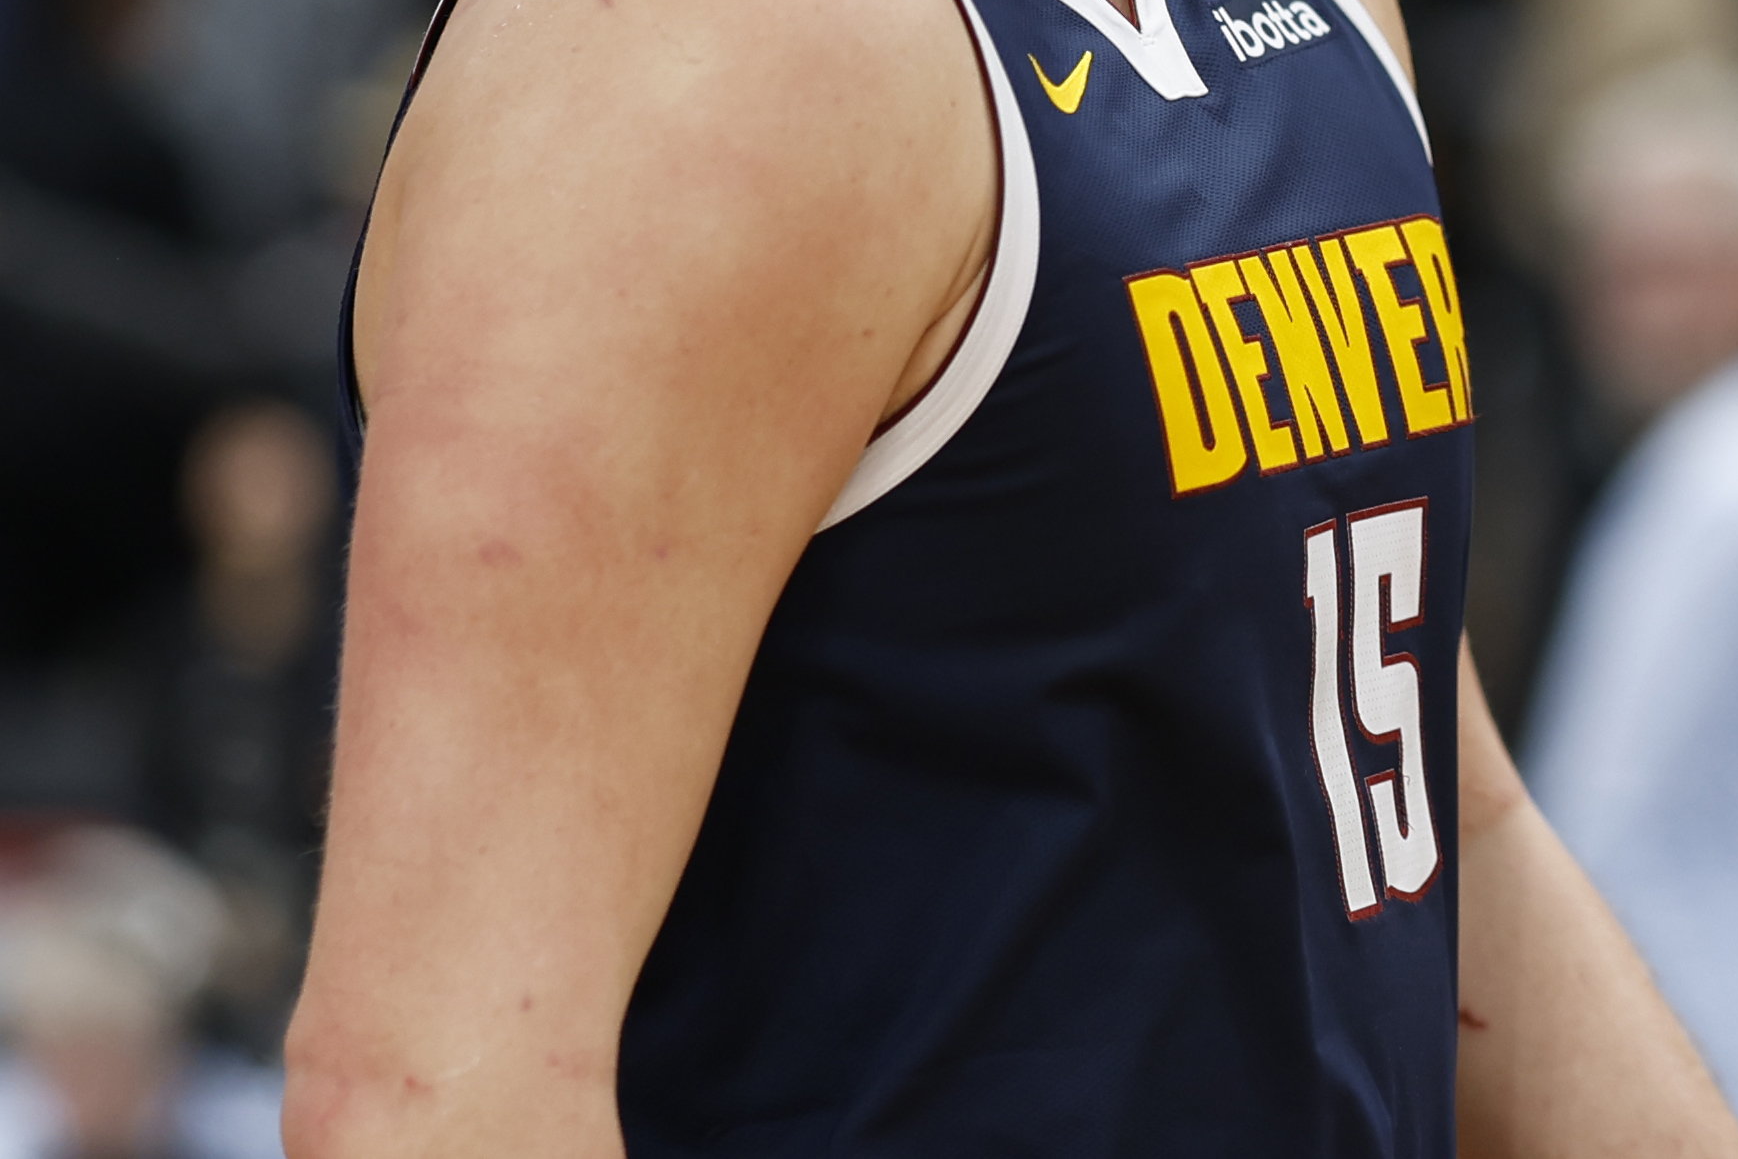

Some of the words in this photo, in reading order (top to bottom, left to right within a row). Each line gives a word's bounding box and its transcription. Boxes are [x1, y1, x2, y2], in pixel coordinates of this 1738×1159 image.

[1212, 0, 1332, 62] ibotta
[1122, 213, 1474, 500] DENVER
[1304, 496, 1443, 922] 15
